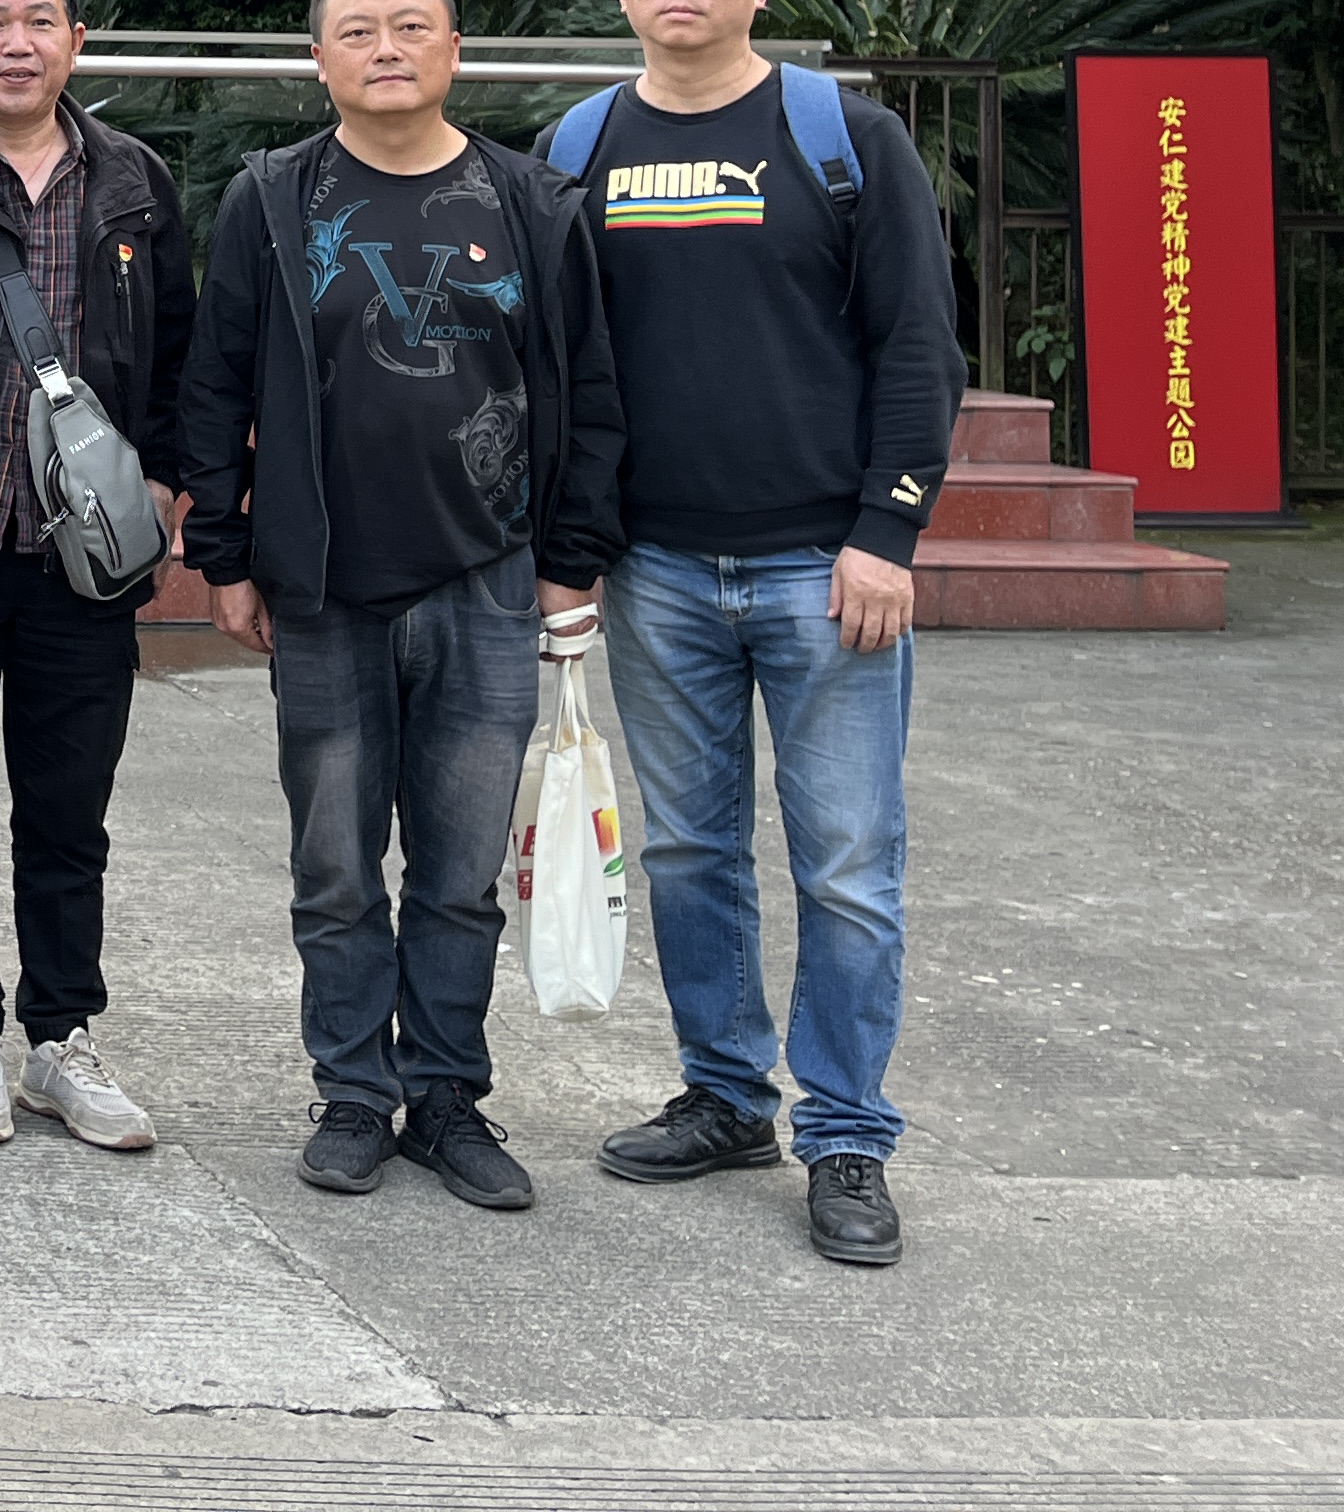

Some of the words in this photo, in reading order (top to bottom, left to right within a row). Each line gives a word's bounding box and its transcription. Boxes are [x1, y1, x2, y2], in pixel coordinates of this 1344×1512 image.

[1158, 96, 1196, 471] 安仁建党精神党建主题公园
[424, 323, 492, 343] MOTION
[68, 427, 106, 456] FASHION
